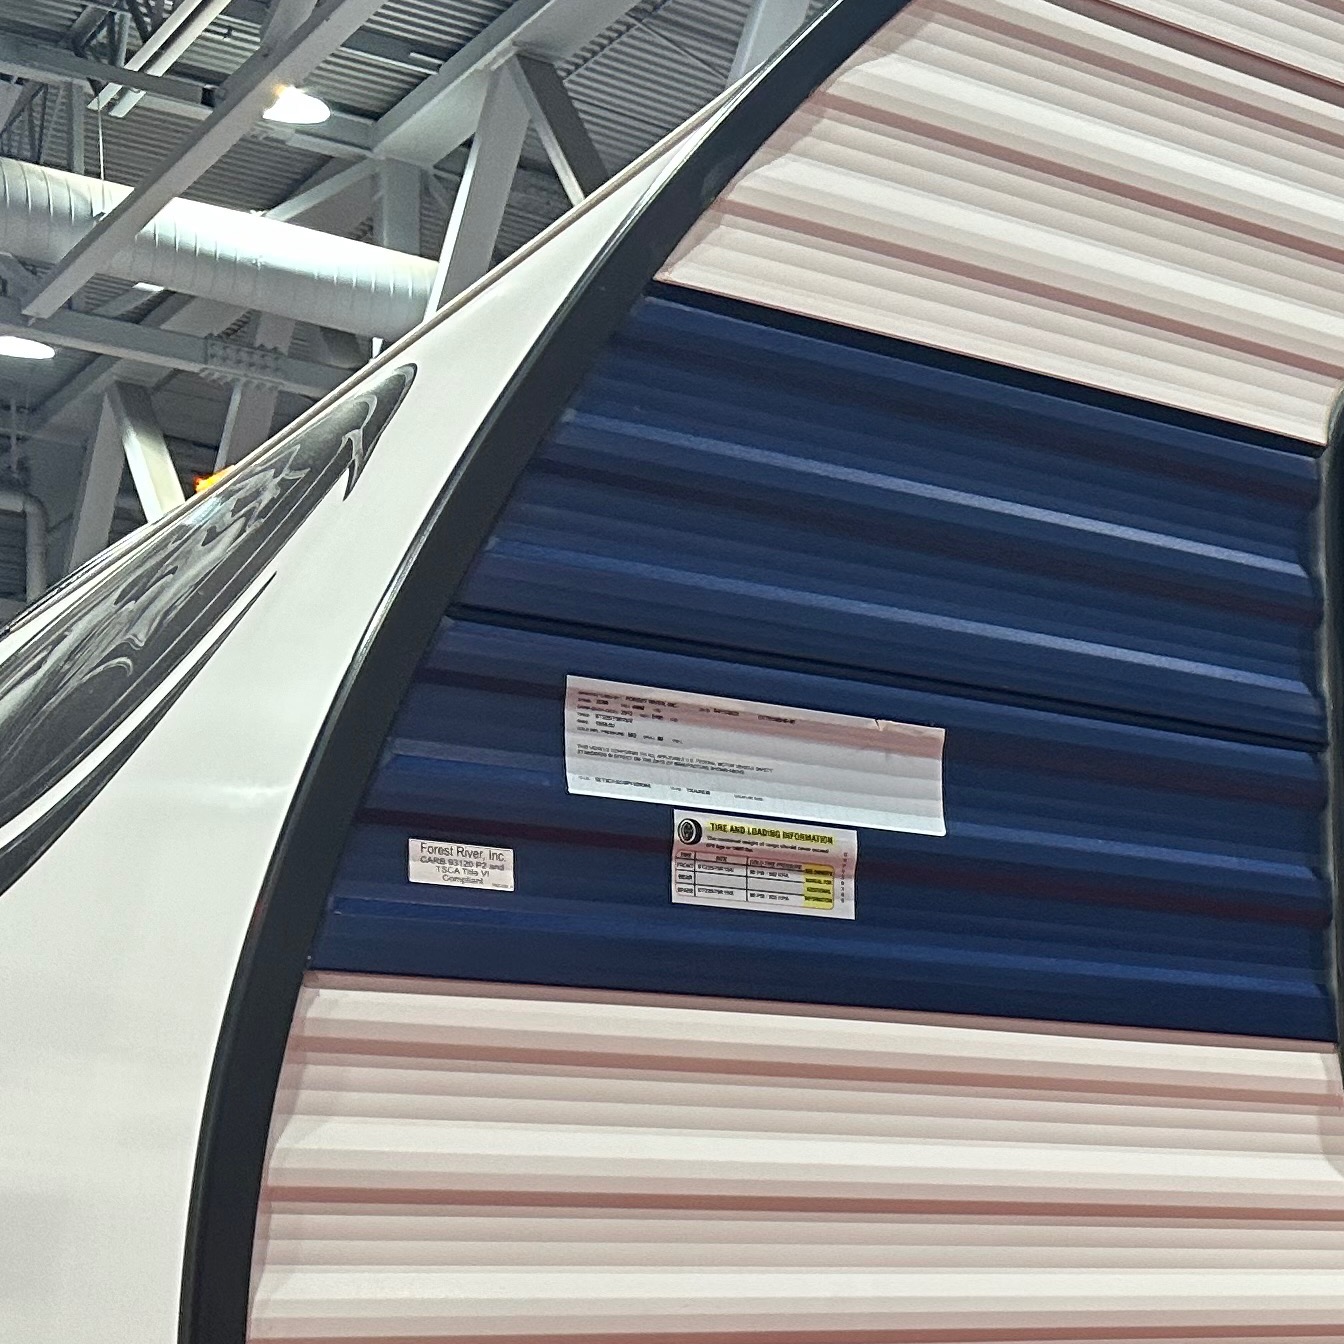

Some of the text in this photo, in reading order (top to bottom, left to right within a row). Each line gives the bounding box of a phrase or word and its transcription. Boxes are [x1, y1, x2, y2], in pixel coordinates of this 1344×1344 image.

[709, 822, 833, 844] TIRE AND LOADING INFORMATION
[420, 842, 506, 862] Forest River, Inc.
[436, 866, 460, 874] TSCA
[488, 863, 505, 871] and
[442, 874, 484, 884] Compliant
